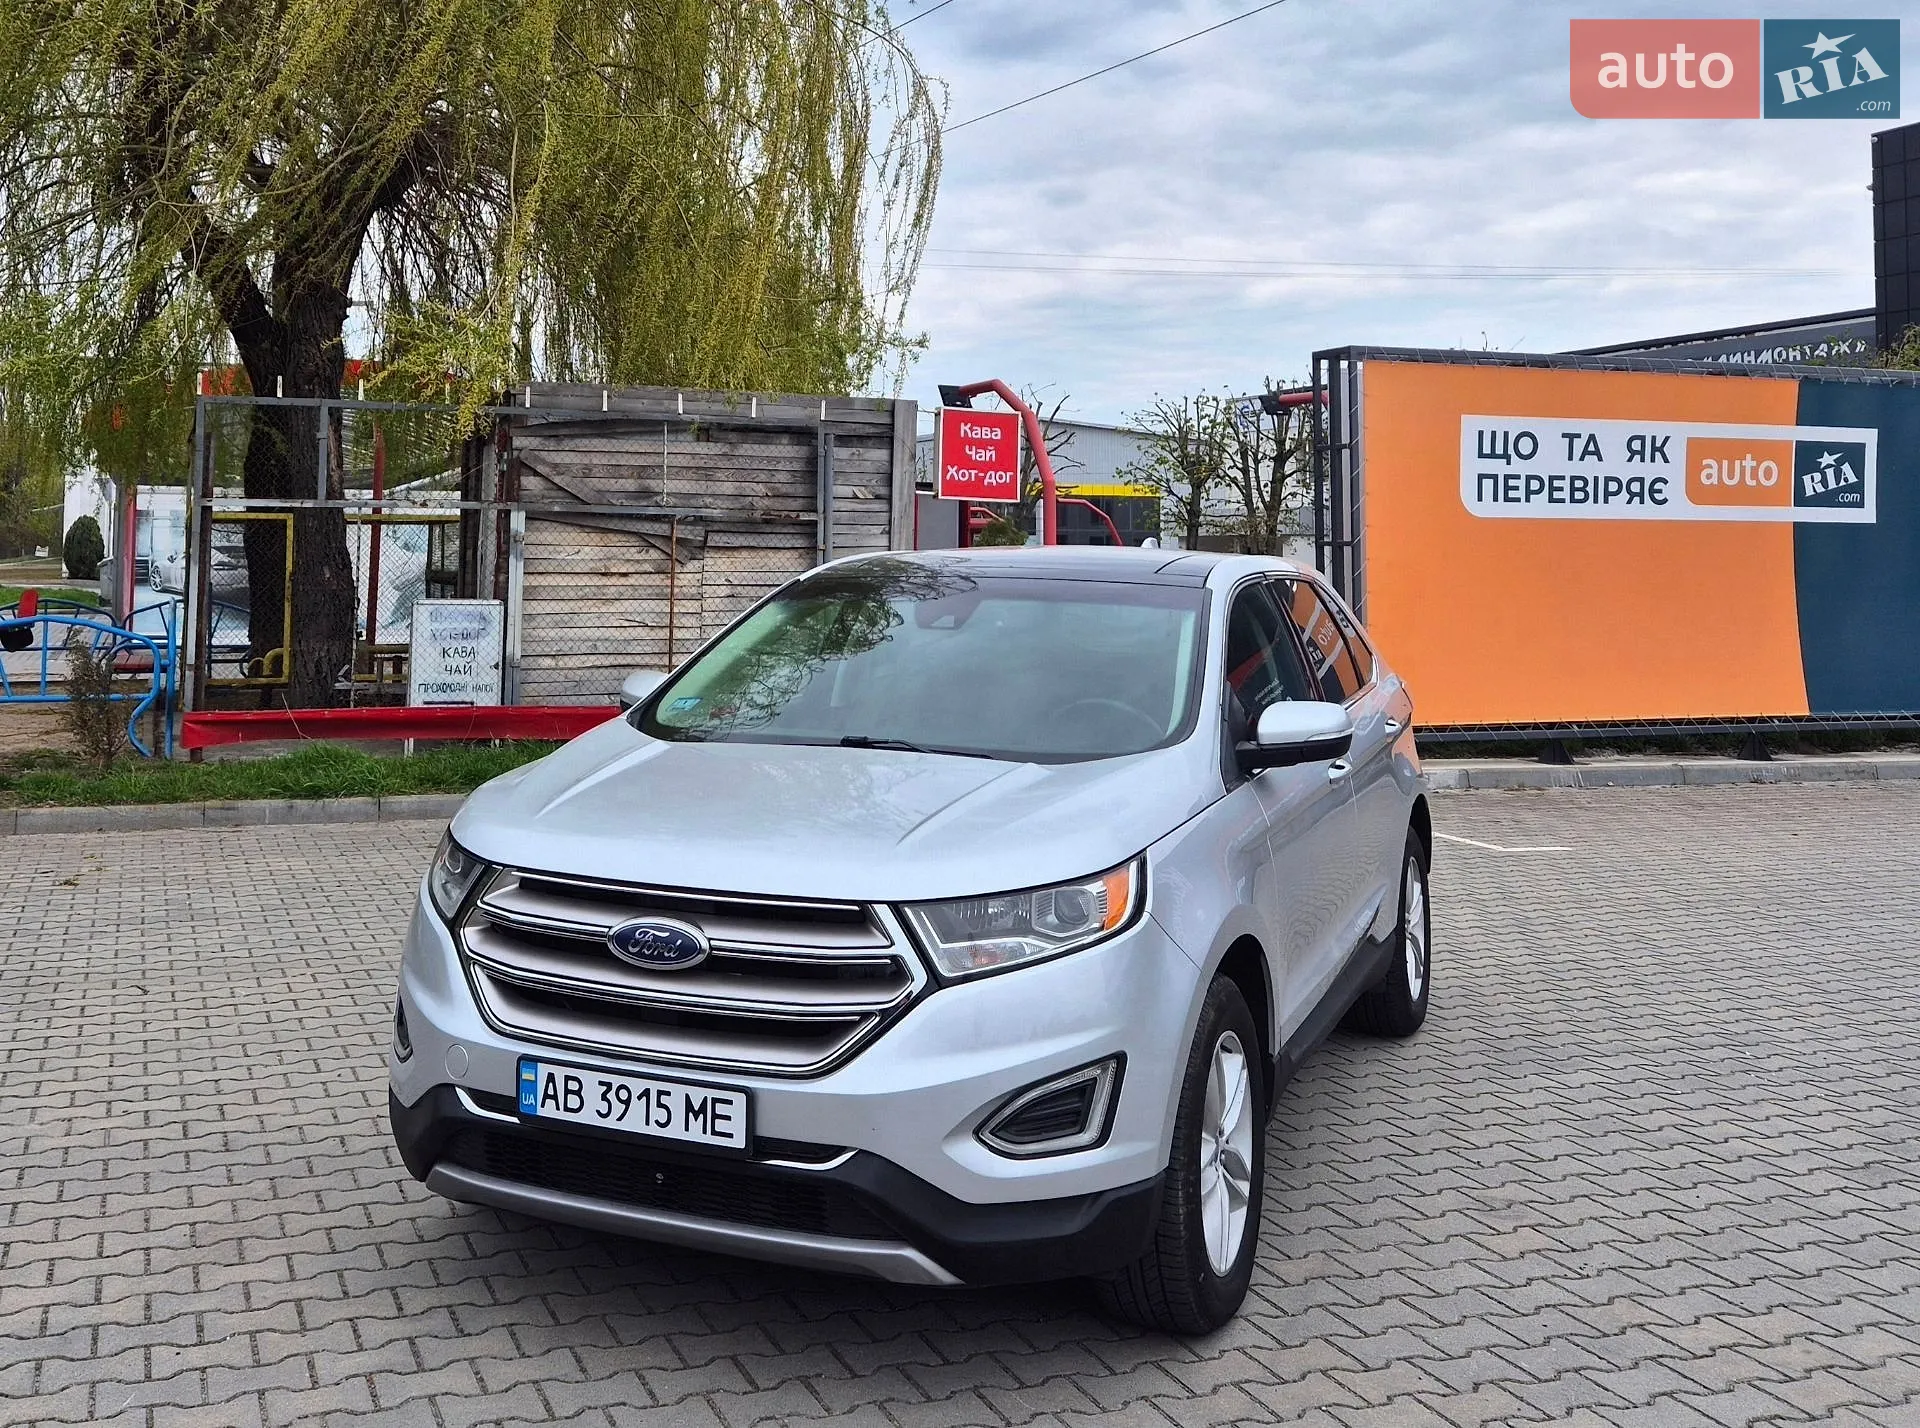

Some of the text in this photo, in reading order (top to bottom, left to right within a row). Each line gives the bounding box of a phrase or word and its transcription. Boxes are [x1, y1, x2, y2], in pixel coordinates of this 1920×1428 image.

[960, 422, 1001, 440] Кава
[965, 444, 996, 462] Чай
[1477, 430, 1671, 465] ЩО ТА ЯК
[946, 465, 1014, 486] Хот-дог
[1700, 453, 1779, 487] auto
[1801, 461, 1859, 497] RIA
[1477, 473, 1670, 505] ПЕРЕВІРЯЄ
[444, 661, 472, 676] ЧАЙ
[628, 928, 682, 957] Ford
[522, 1093, 535, 1107] UA
[540, 1071, 734, 1139] AB 3915 ME
